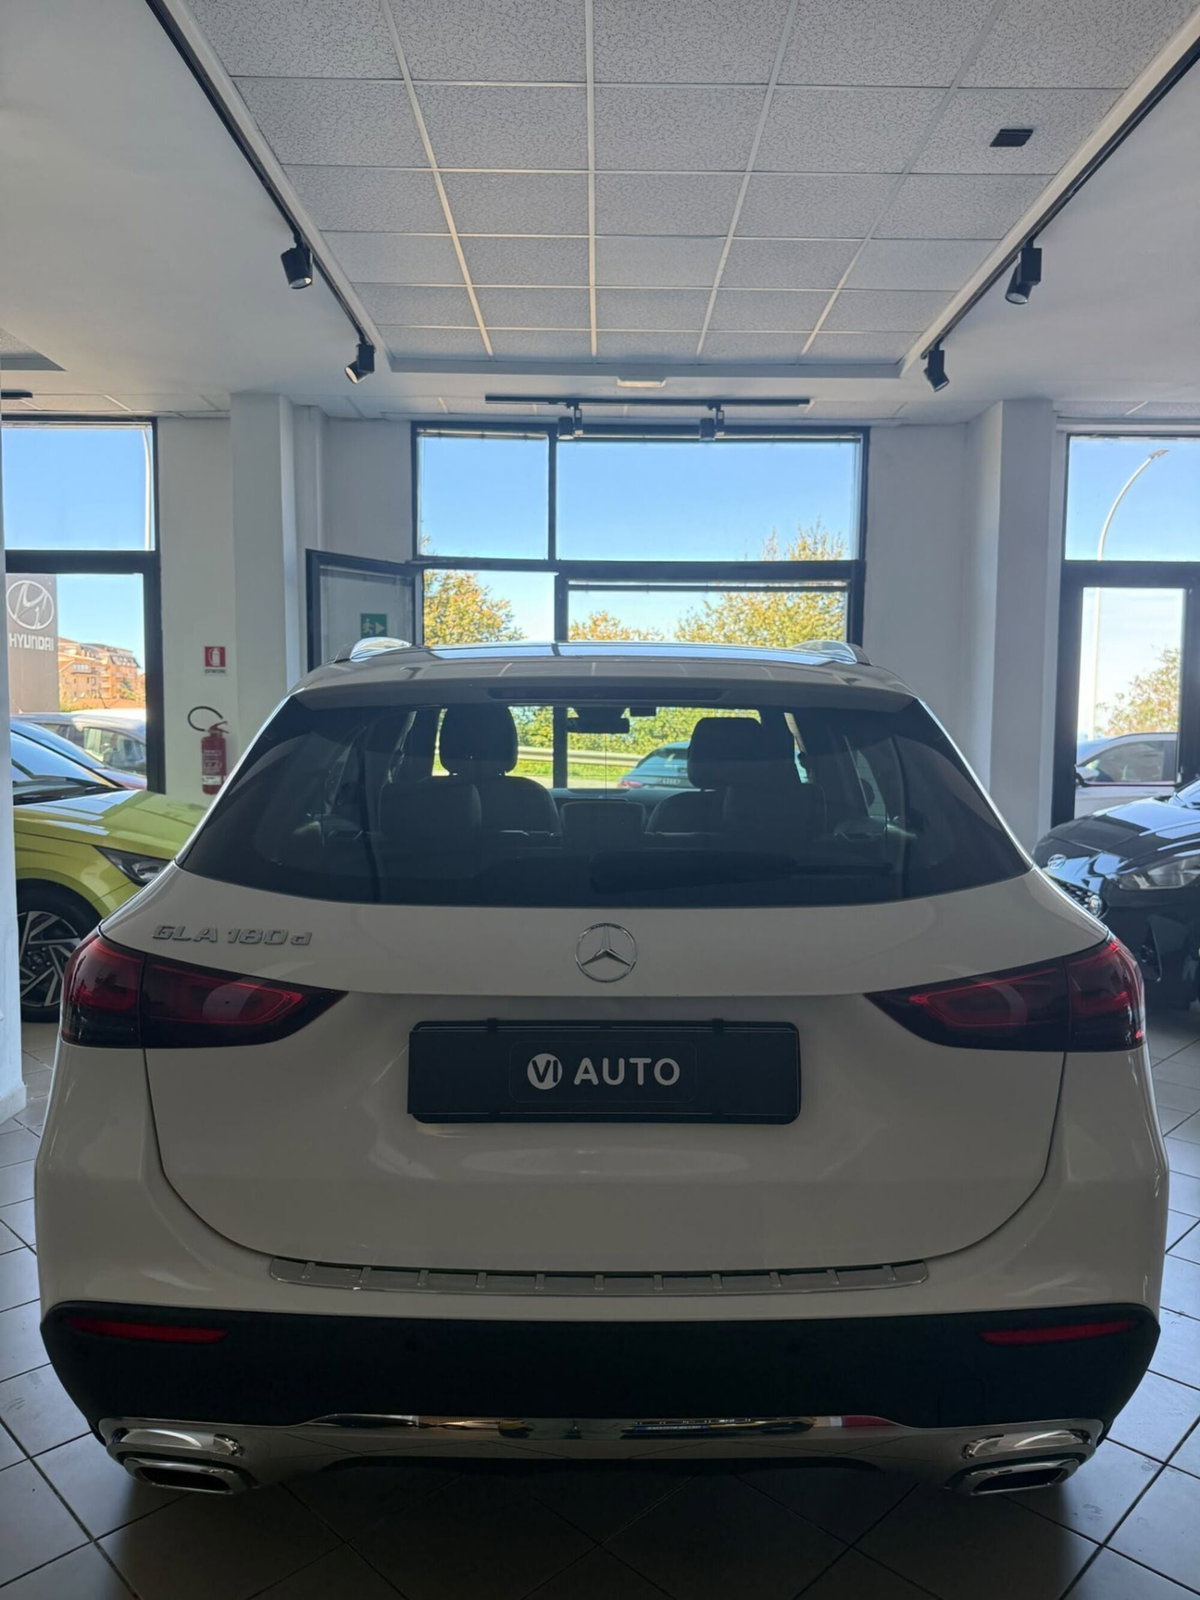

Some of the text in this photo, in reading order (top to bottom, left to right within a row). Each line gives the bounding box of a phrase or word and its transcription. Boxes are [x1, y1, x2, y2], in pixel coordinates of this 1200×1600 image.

[9, 633, 54, 651] HYUNDAI
[152, 925, 312, 945] GLA 180 d
[573, 1057, 681, 1086] AUTO
